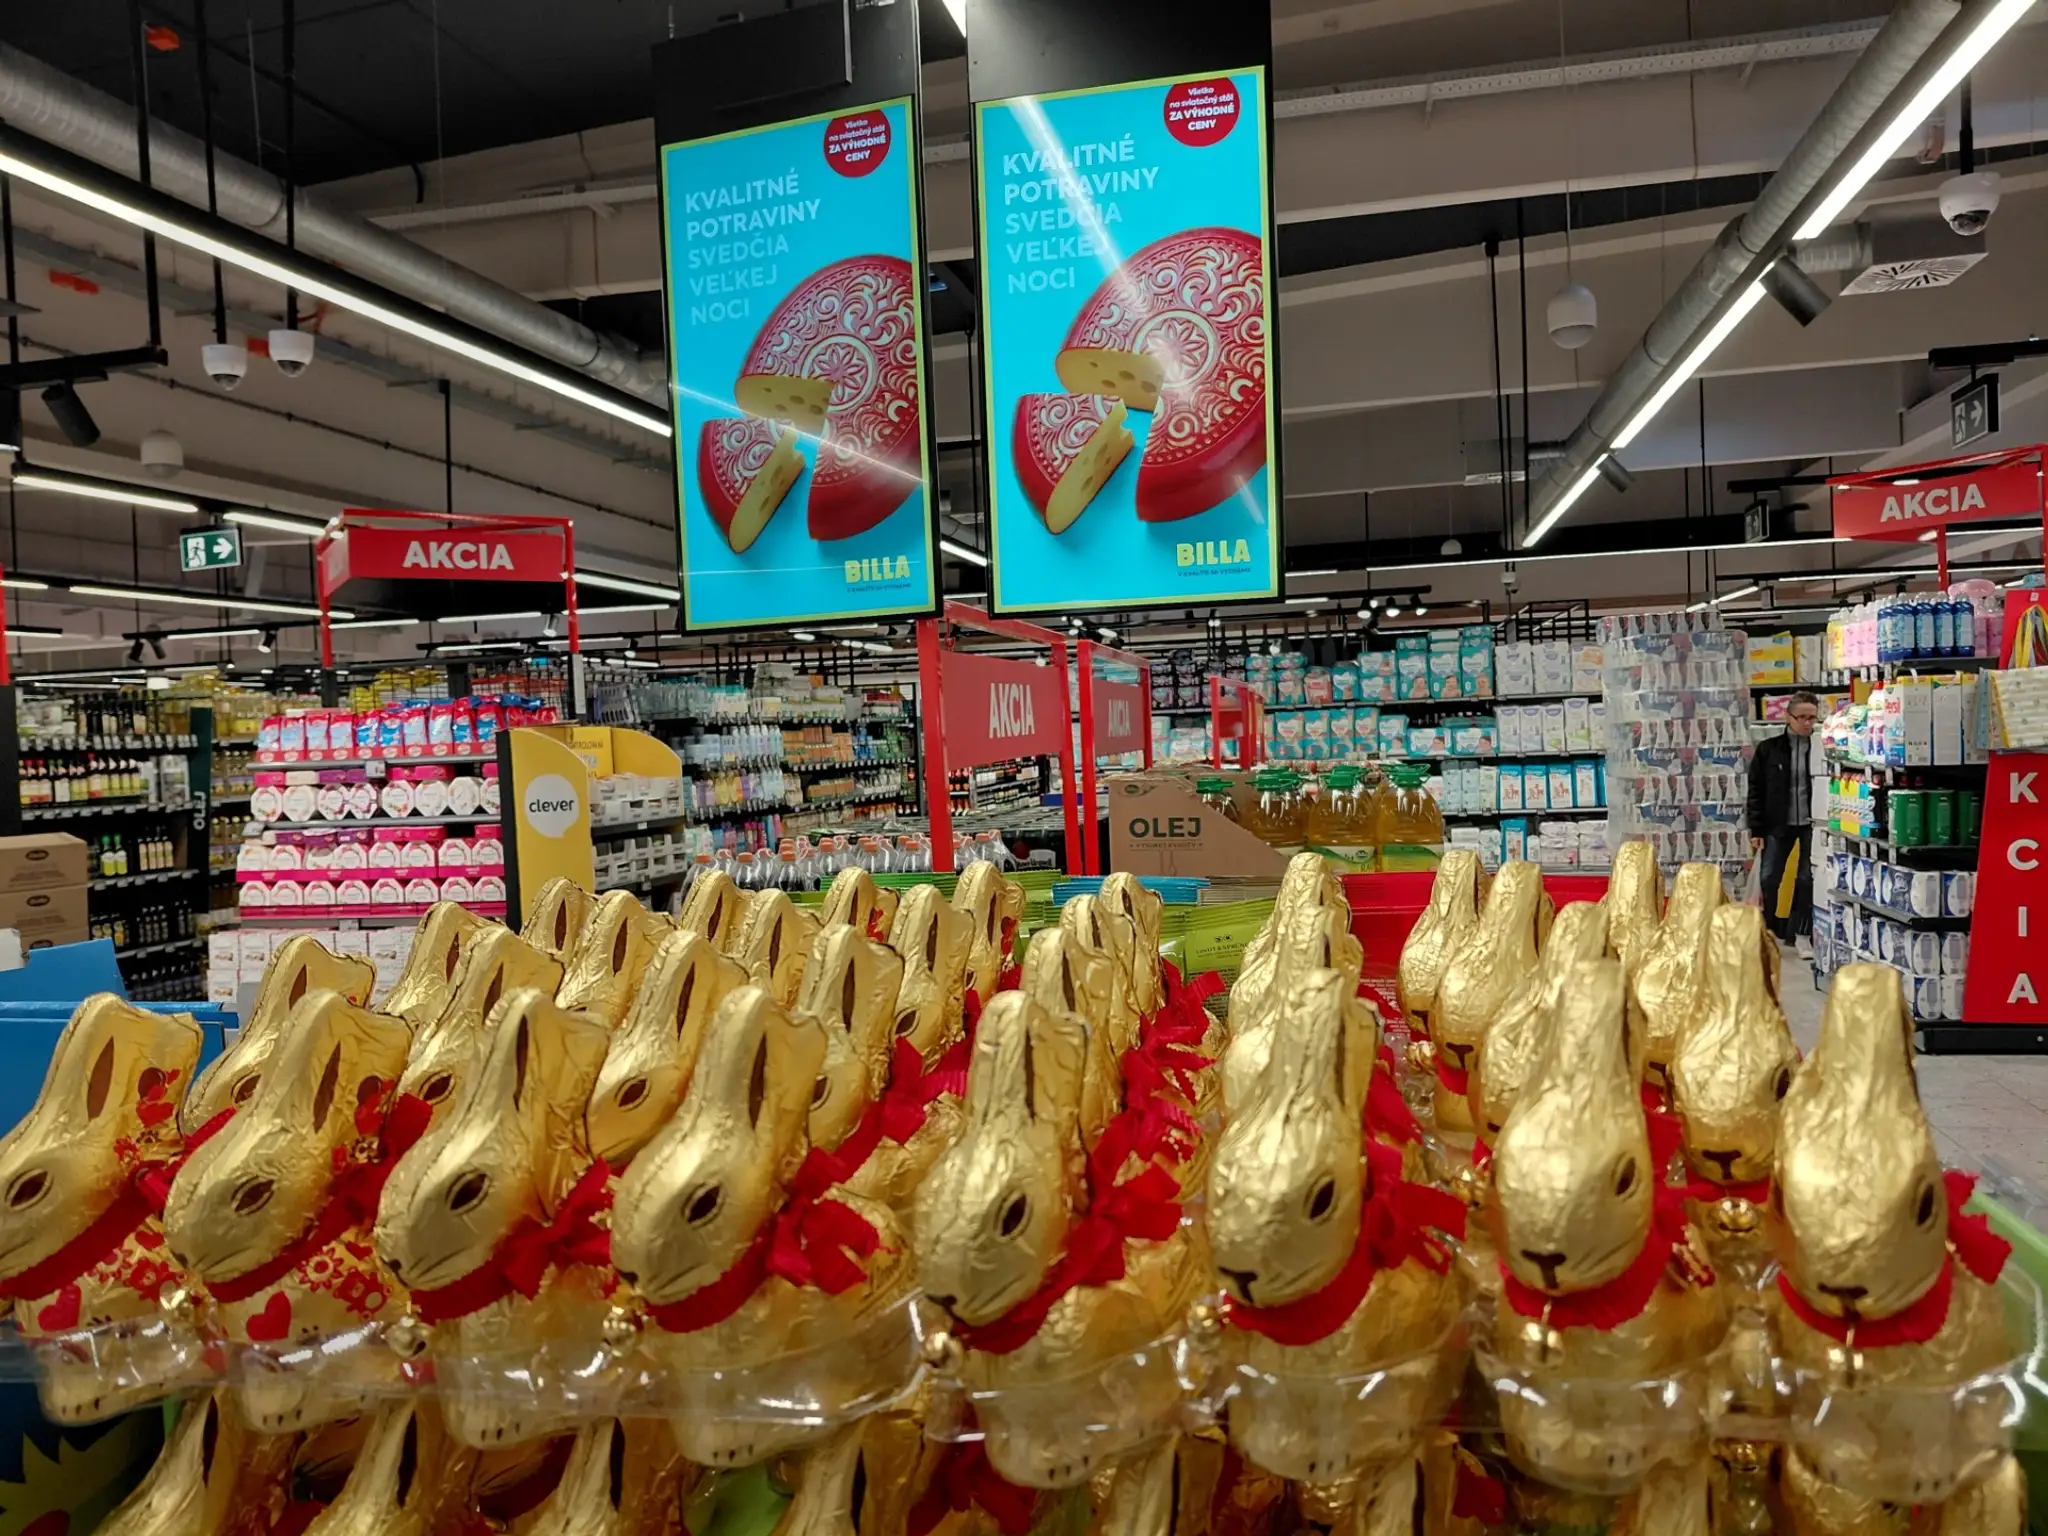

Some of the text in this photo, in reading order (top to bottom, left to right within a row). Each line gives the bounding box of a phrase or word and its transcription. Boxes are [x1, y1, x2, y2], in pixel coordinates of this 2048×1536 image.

[1169, 102, 1235, 121] ZA VÝHODNÉ
[1187, 119, 1217, 130] CENY
[828, 133, 887, 154] ZA VÝHODNÉ
[845, 150, 871, 162] CENY
[1003, 133, 1135, 175] KVALITNÉ
[685, 167, 799, 214] KVALITNÉ
[1004, 167, 1160, 206] POTRAVINY
[686, 198, 821, 241] POTRAVINY
[688, 232, 789, 269] SVEDČIA
[689, 264, 777, 297] VEĽKEJ
[1008, 267, 1075, 294] NOCI
[691, 299, 749, 326] NOCI
[1879, 483, 1986, 523] AKCIA
[402, 541, 515, 570] AKCIA
[1176, 538, 1251, 567] BILLA
[845, 555, 910, 583] BILLA
[989, 683, 1036, 739] AKCIA
[529, 799, 575, 814] clever
[1129, 817, 1201, 838] OLEJ
[2007, 772, 2040, 1004] KCIA
